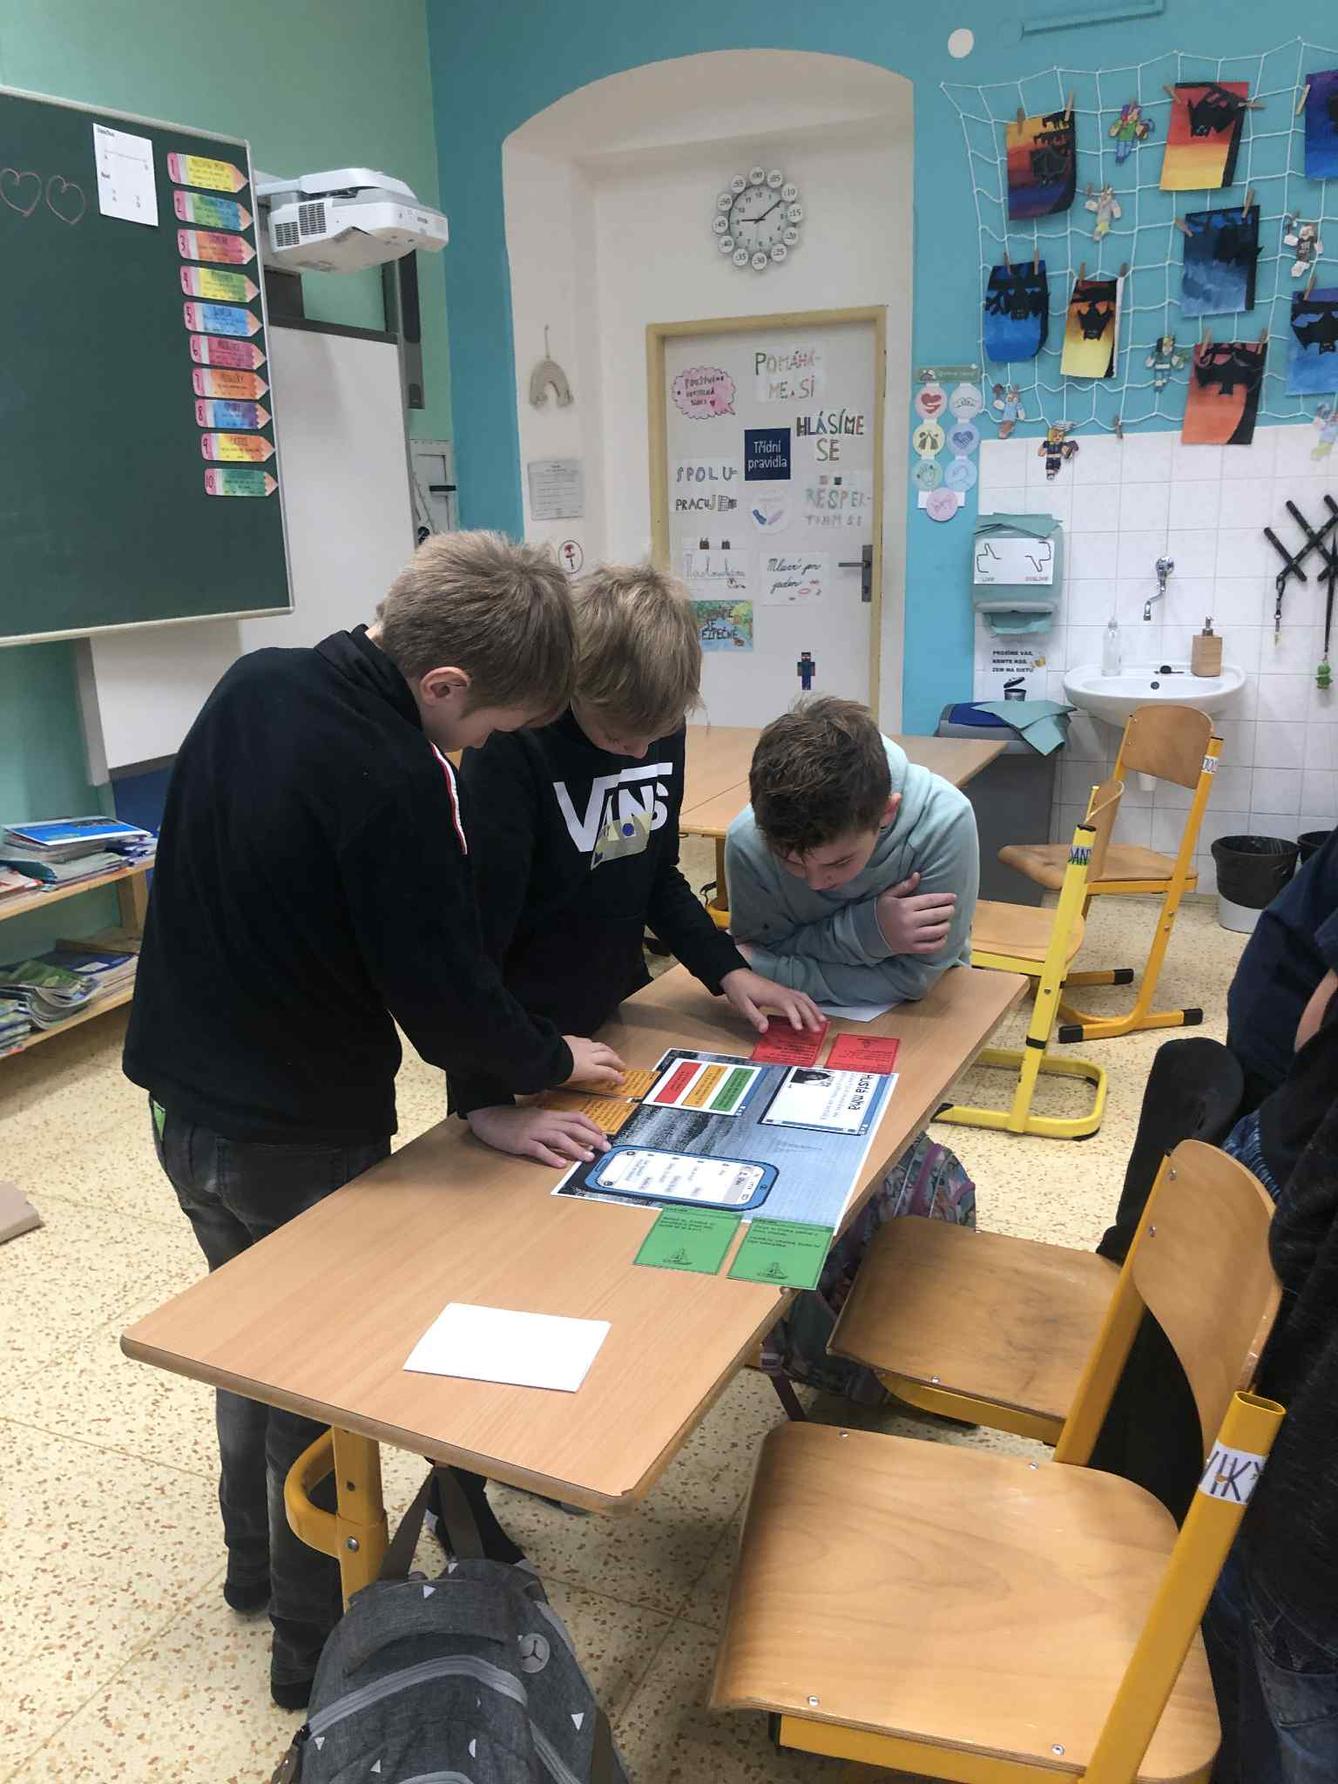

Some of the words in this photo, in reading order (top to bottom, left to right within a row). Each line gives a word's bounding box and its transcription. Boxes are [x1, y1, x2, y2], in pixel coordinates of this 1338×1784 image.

[796, 408, 864, 437] HLÁSÍME
[816, 438, 840, 461] SE
[747, 455, 788, 472] pravidla
